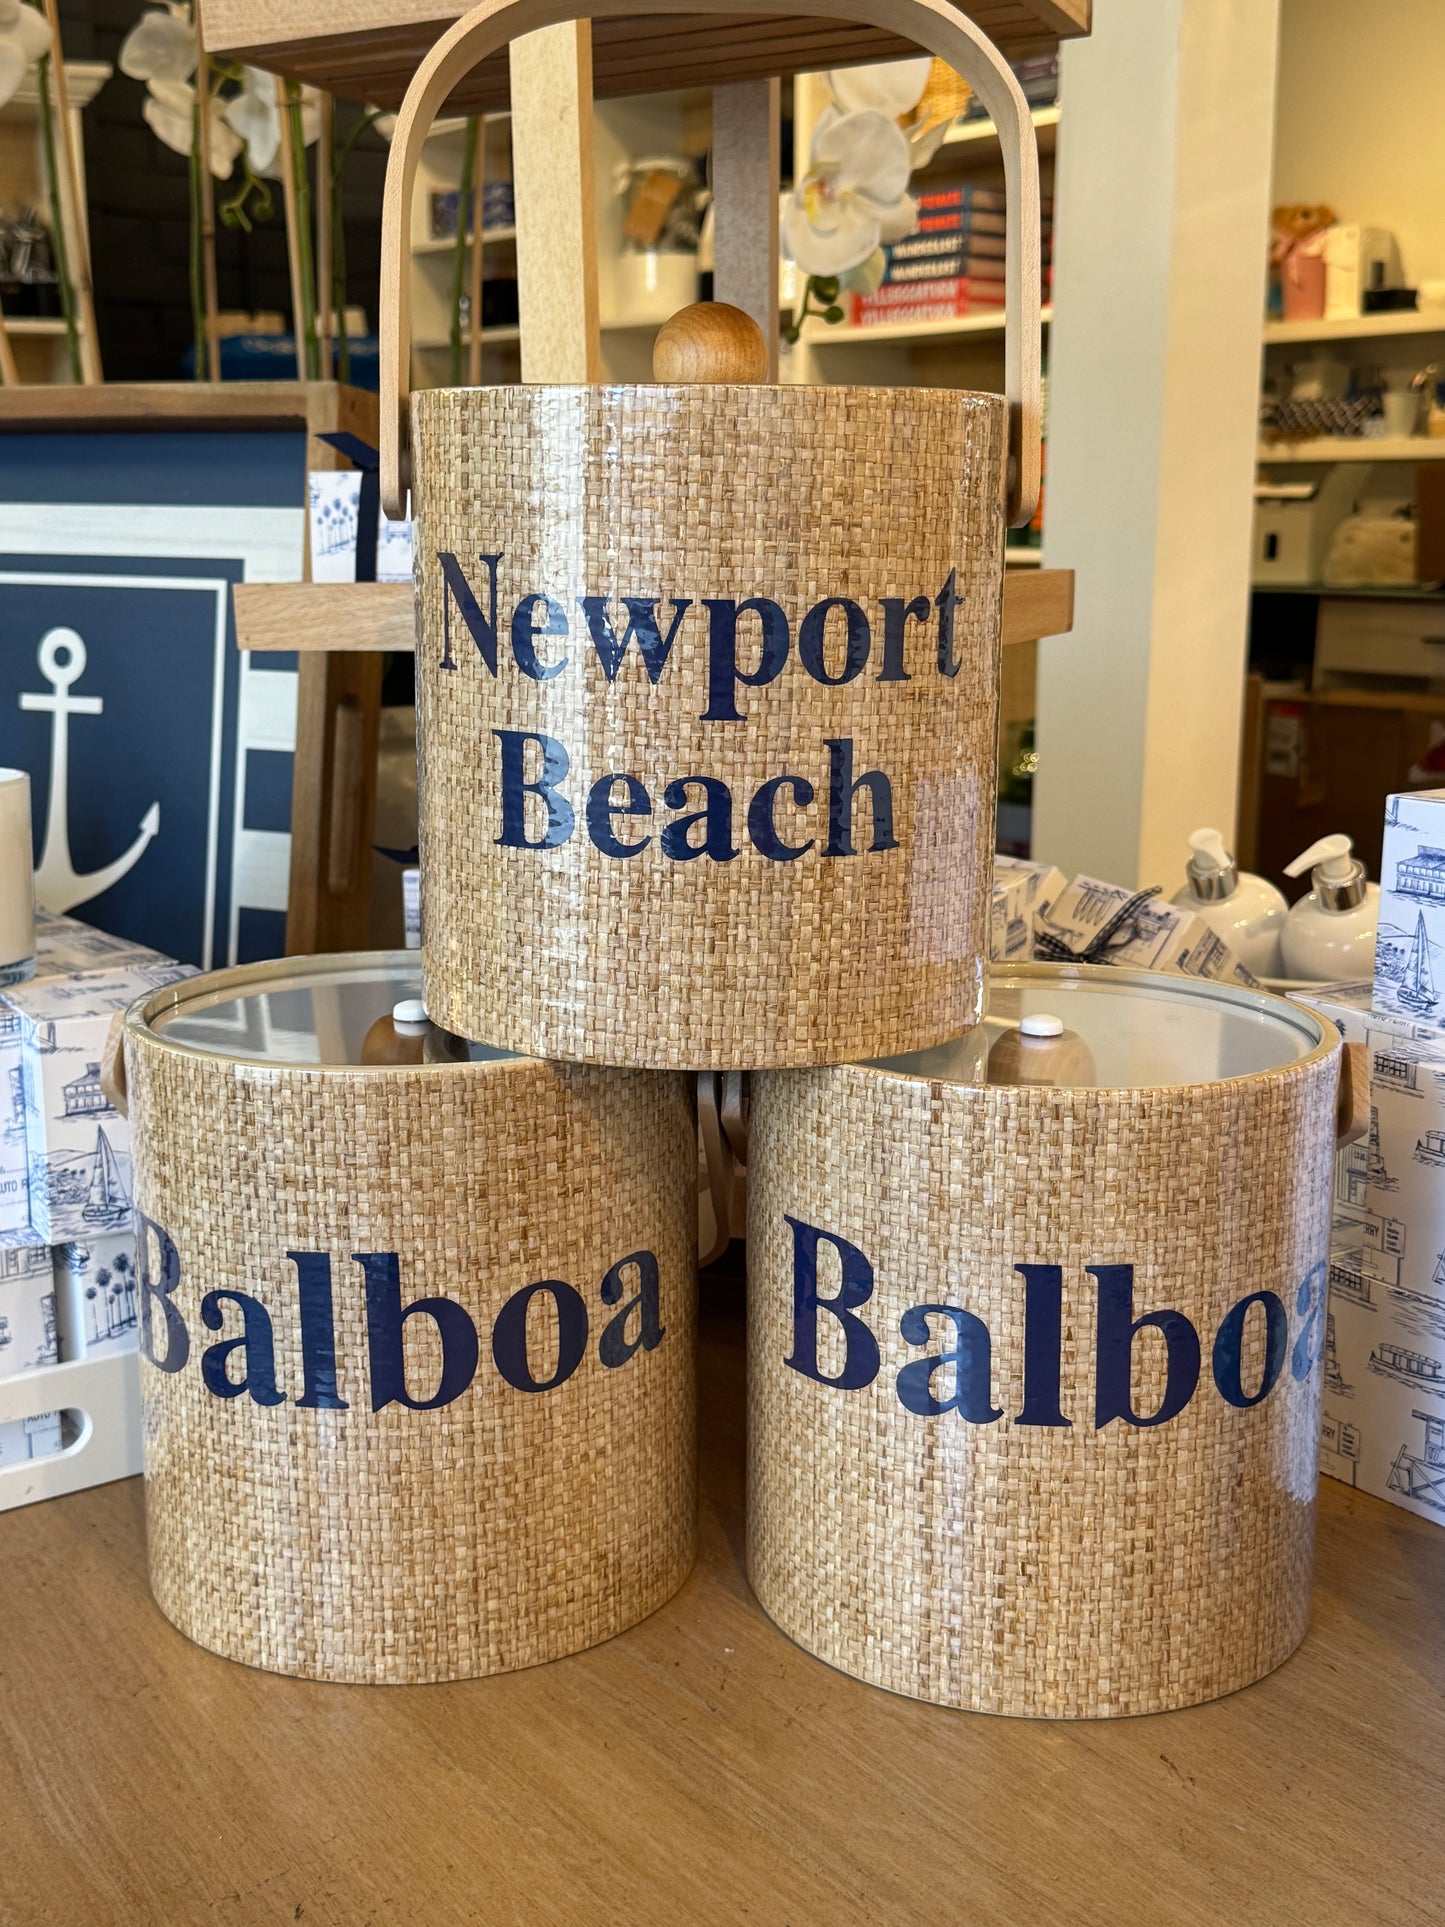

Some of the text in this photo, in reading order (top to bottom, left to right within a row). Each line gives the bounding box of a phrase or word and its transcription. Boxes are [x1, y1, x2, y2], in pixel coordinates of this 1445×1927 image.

[437, 552, 963, 720] Newport
[491, 729, 900, 861] Beach
[0, 1180, 18, 1194] UTO
[136, 1210, 666, 1414] Balboa
